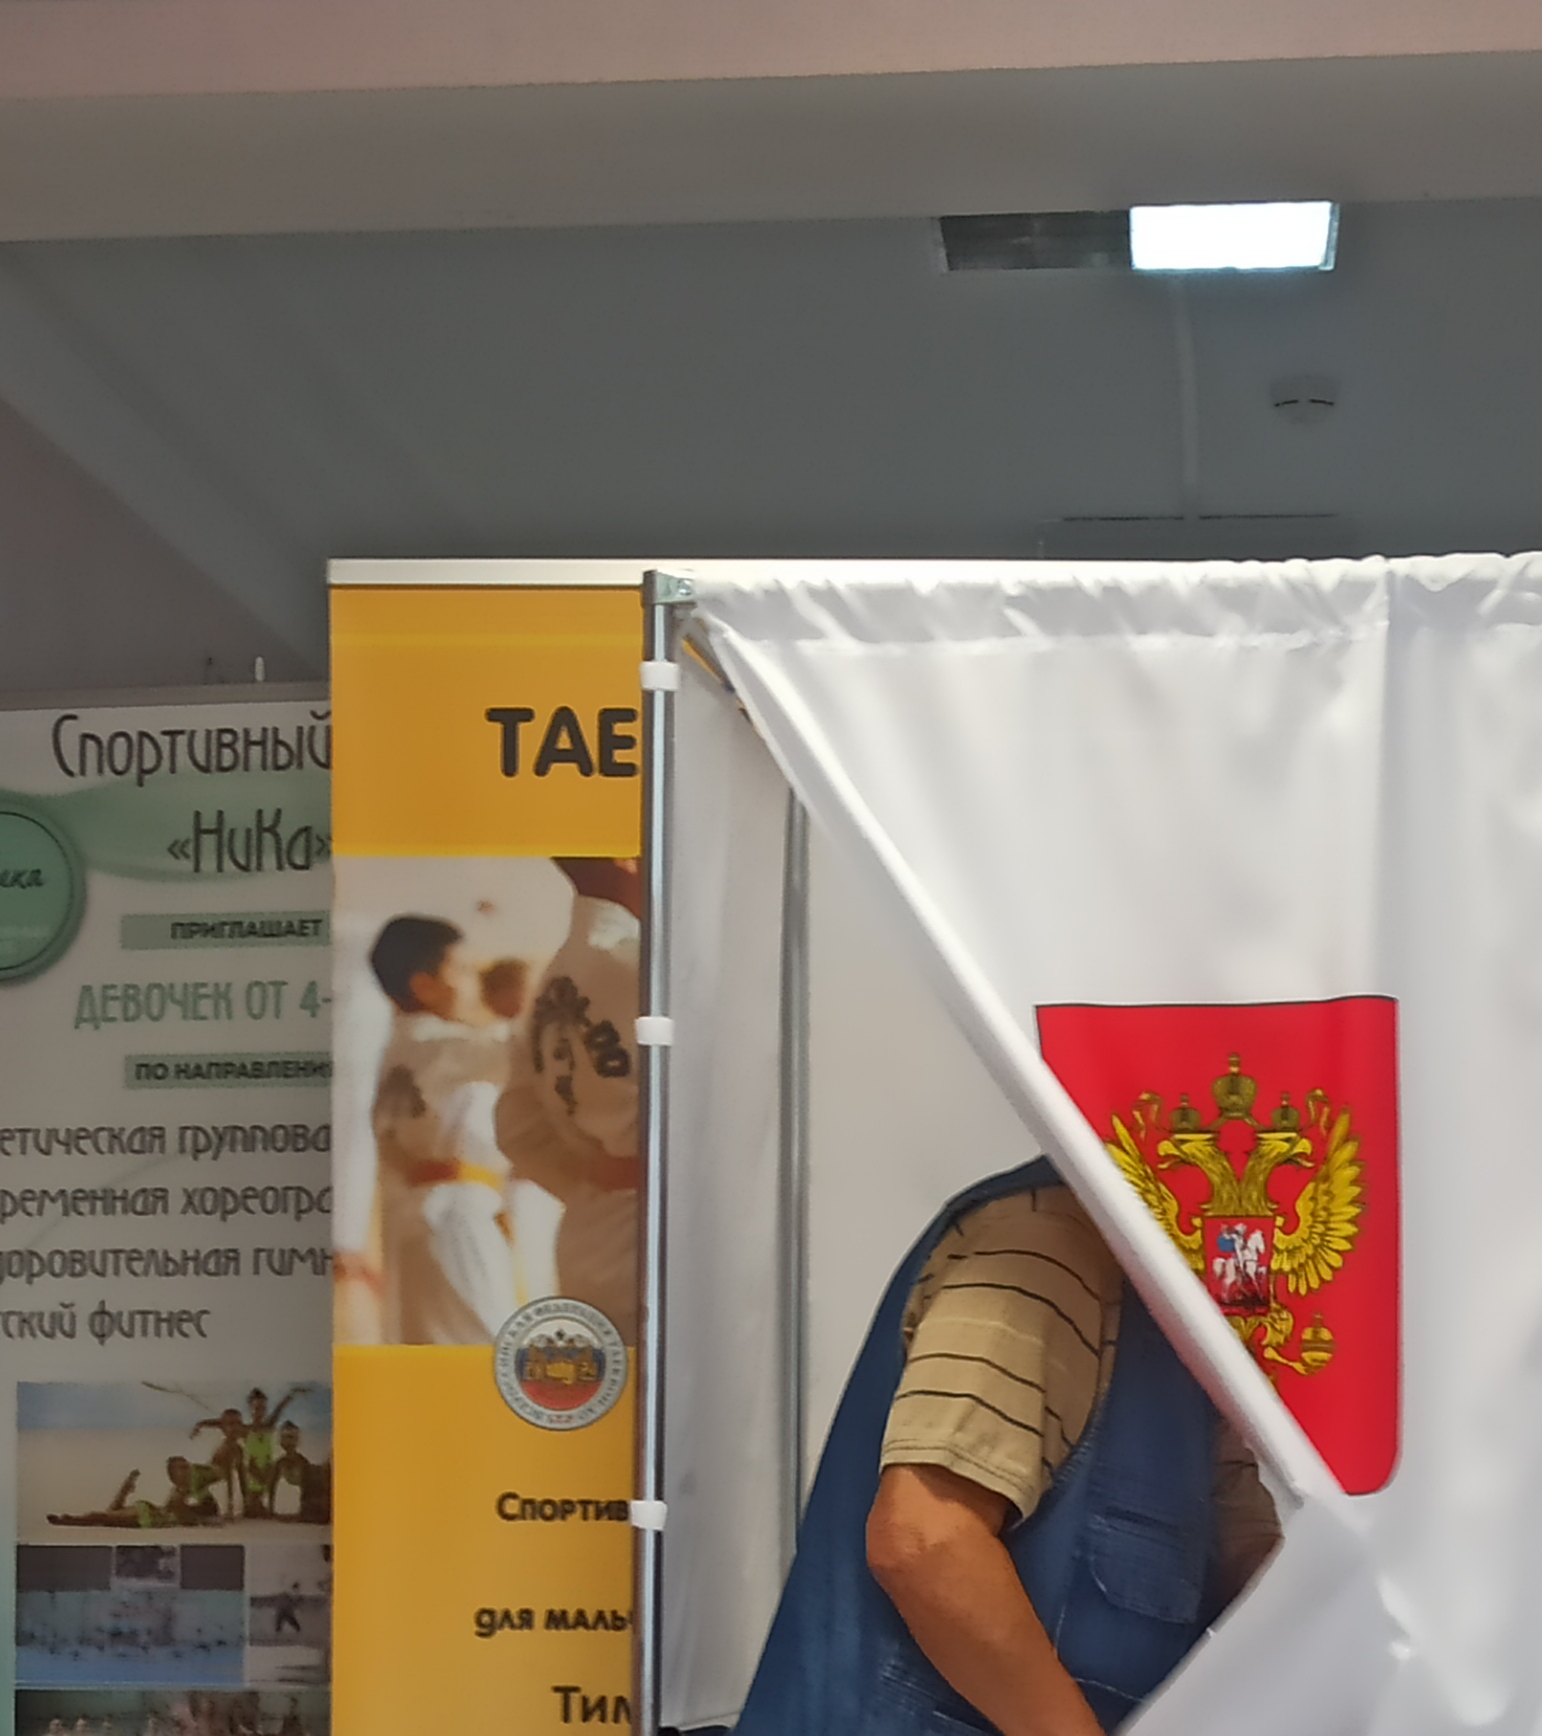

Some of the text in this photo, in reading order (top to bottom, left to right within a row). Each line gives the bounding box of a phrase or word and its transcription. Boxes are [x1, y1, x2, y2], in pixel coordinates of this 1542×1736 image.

[52, 710, 332, 787] Спортивный
[170, 917, 323, 940] ПРИГЛАШАЕТ
[74, 982, 234, 1030] ДЕВОЧЕК
[244, 980, 288, 1021] ОТ
[135, 1062, 169, 1081] ПО
[88, 1300, 212, 1345] фитнес
